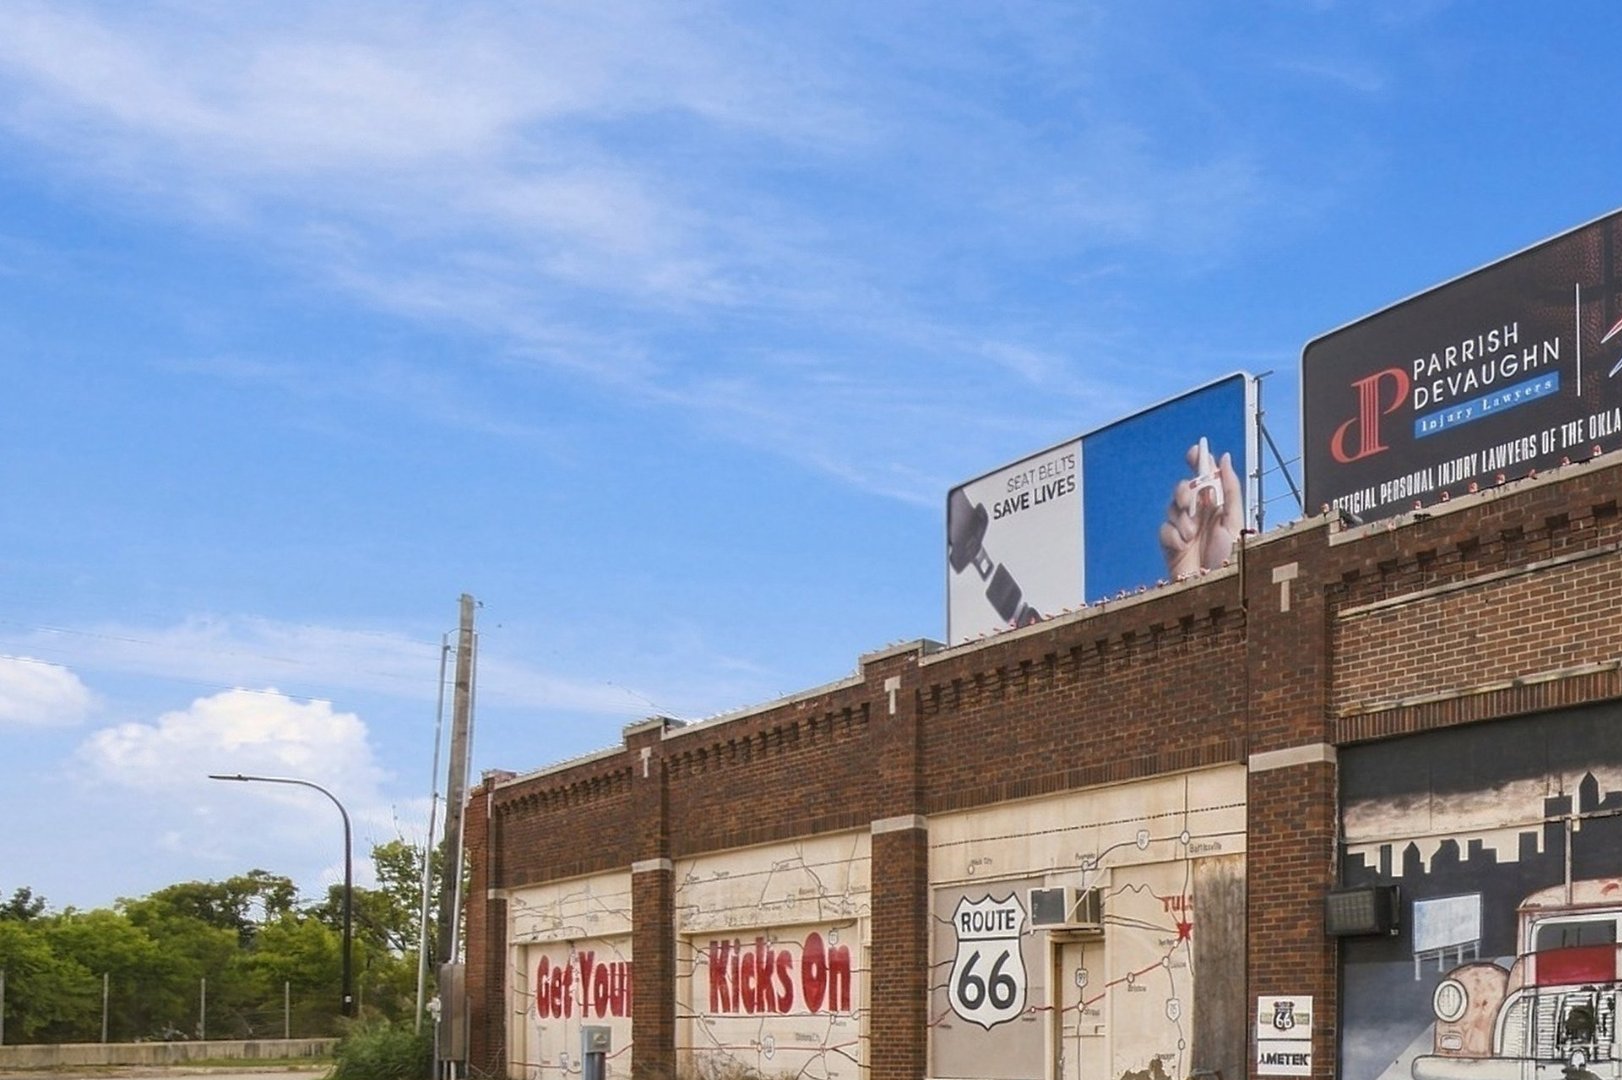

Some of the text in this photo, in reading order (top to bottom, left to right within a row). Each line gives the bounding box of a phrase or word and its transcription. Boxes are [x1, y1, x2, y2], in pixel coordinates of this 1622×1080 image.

[1413, 321, 1518, 381] PARRISH
[1414, 336, 1560, 410] DEVAUGHN
[1421, 379, 1553, 432] Injury Lawyers
[1007, 454, 1075, 493] SEAT BELTS
[1380, 467, 1434, 503] PERSONAL
[1438, 454, 1477, 487] INJURY
[1482, 434, 1537, 473] LAWYERS
[1542, 424, 1556, 455] OF
[1561, 418, 1584, 448] THE
[993, 474, 1076, 520] SAVE LIVES
[961, 909, 1016, 932] ROUTE
[537, 952, 573, 1019] Get
[709, 936, 793, 1014] Kicks
[801, 932, 850, 1013] On
[957, 949, 1017, 1011] 66
[1275, 1012, 1293, 1028] 66
[1259, 1052, 1311, 1067] AMETEK
